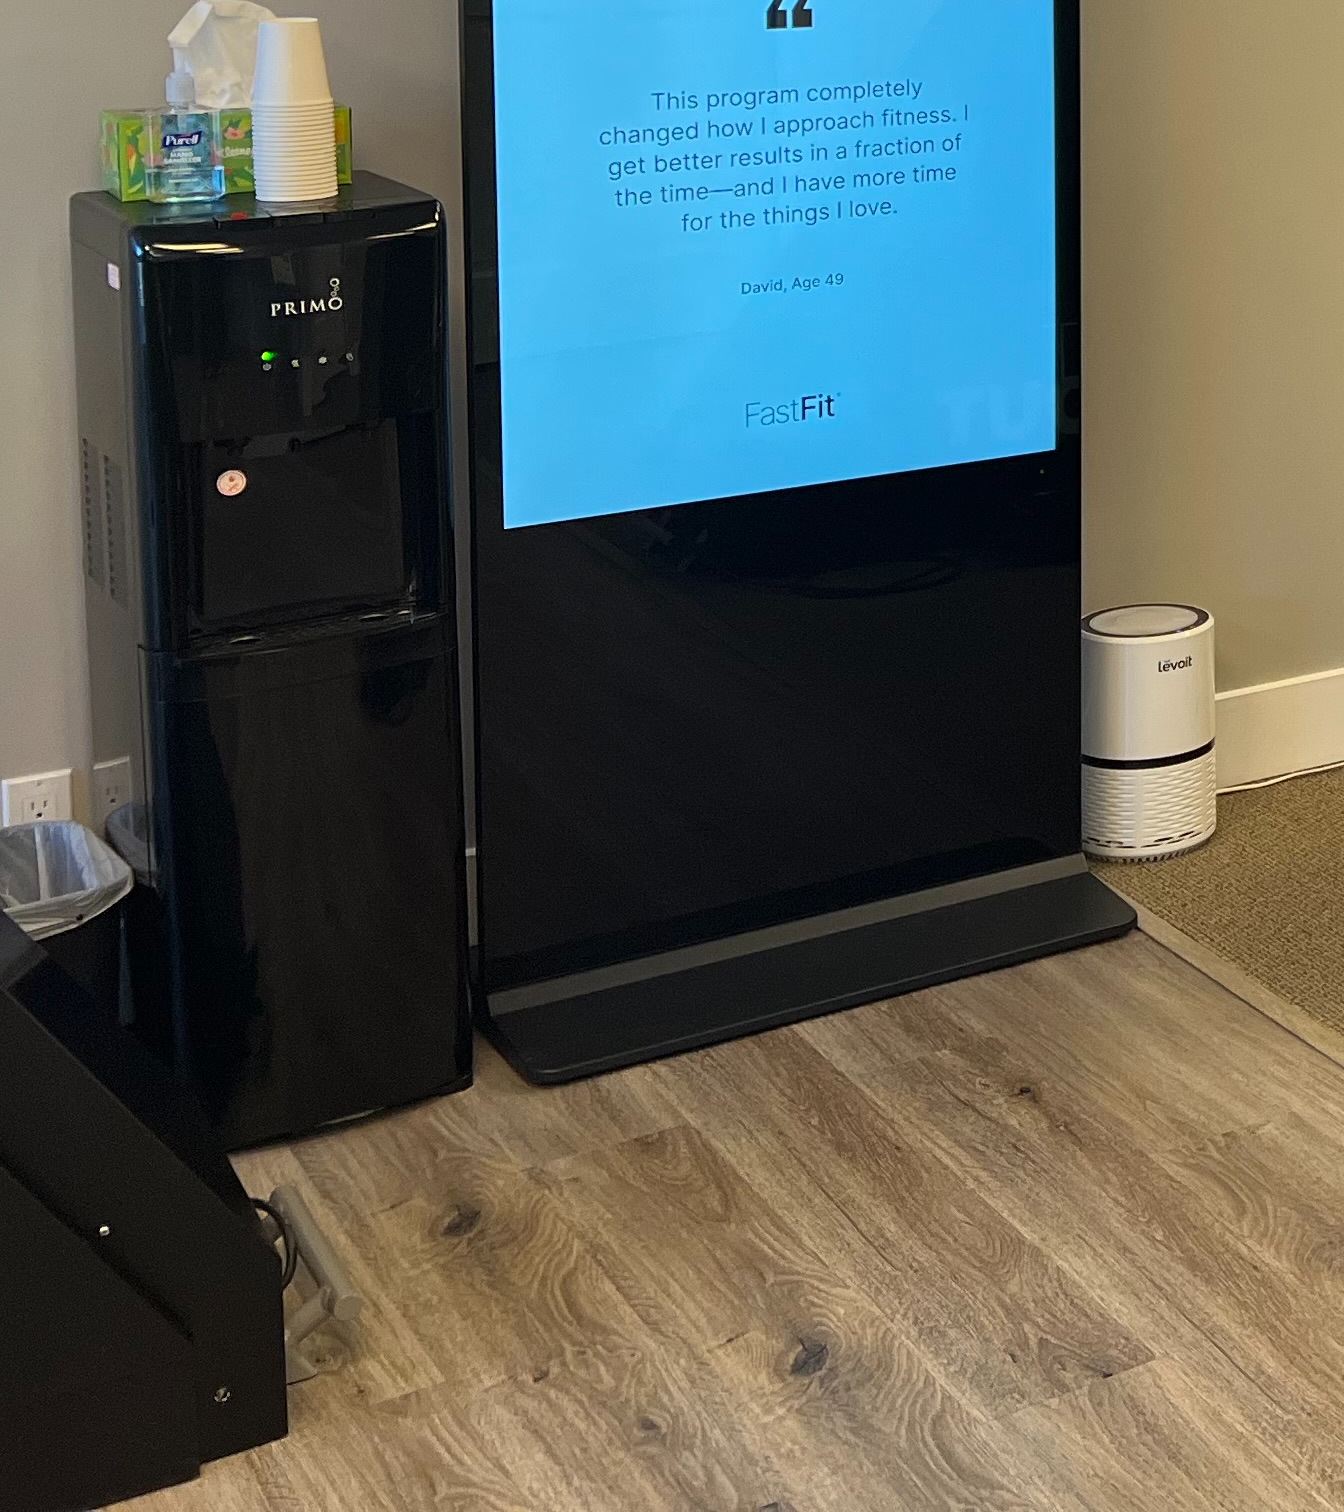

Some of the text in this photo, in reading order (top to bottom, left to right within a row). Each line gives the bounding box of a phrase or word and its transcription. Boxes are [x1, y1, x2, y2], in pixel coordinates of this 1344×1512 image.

[650, 78, 923, 113] This program completely
[599, 104, 968, 147] changed how I approach fitness. I
[608, 132, 962, 181] get better results in a fraction of
[614, 188, 653, 207] the
[782, 175, 787, 194] I
[794, 174, 846, 193] have
[853, 170, 906, 188] more
[912, 165, 957, 184] time
[681, 200, 898, 232] for the things I love.
[741, 272, 844, 295] David, Age 49
[270, 296, 343, 317] PRIMO
[745, 393, 836, 428] FastFit
